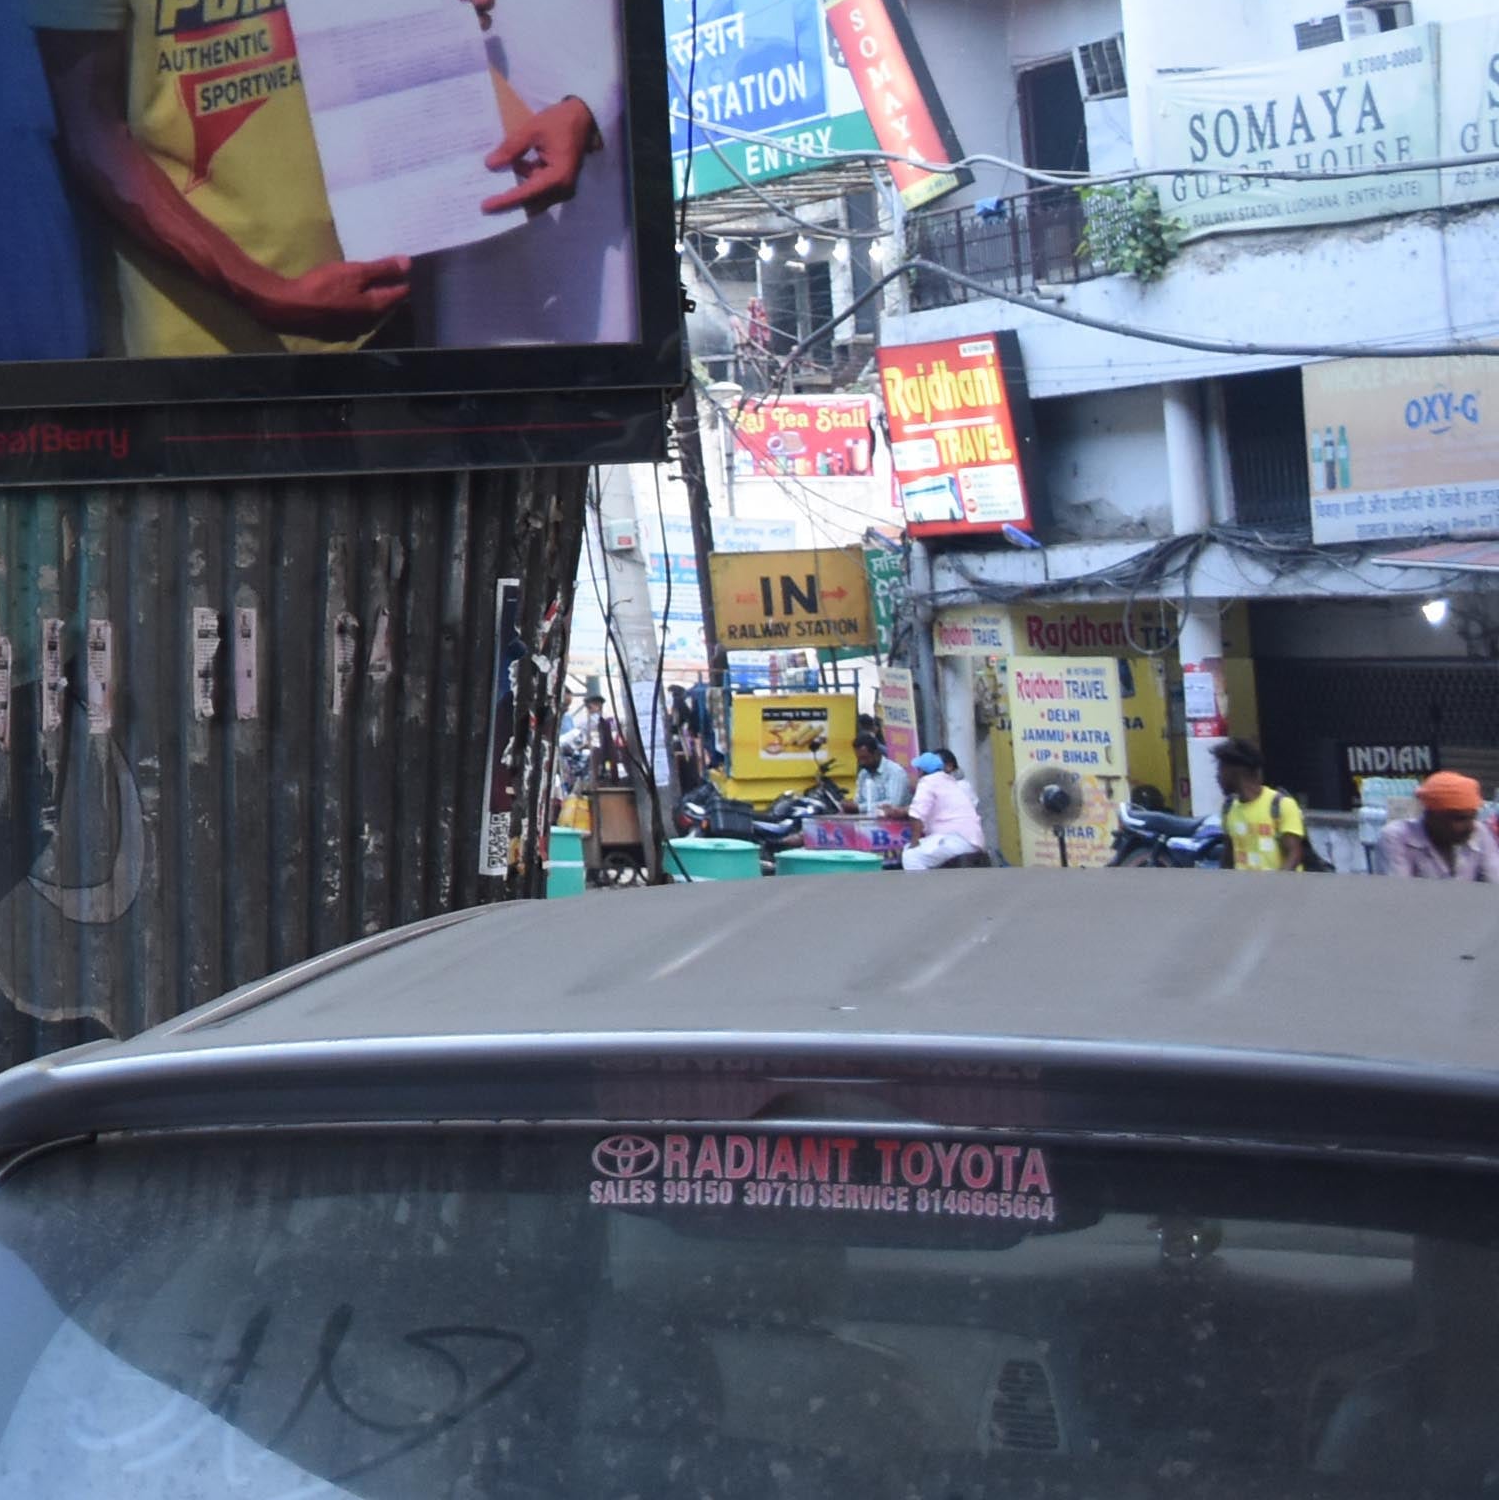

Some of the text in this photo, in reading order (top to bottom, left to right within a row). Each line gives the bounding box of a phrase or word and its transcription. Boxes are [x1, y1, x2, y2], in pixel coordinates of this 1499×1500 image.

[157, 28, 271, 74] AUTHENTIC
[199, 63, 303, 115] SPORTWEA
[692, 60, 807, 124] STATION
[1188, 80, 1385, 164] SOMAYA
[744, 126, 834, 177] ENTRY
[1171, 159, 1275, 202] GUEST
[1294, 135, 1412, 176] HOUSE
[882, 353, 1003, 424] Rajdhani
[1404, 389, 1480, 430] OXY-G
[771, 407, 810, 430] Tea
[816, 407, 868, 432] Stall
[934, 423, 1013, 466] TRAVEL
[760, 573, 821, 617] IN
[727, 618, 859, 640] RAILWAY STATION
[972, 627, 1003, 649] TRAVEL
[1026, 614, 1136, 653] Rajdhani
[1015, 671, 1109, 705] Rajdhani TRAVEL
[1021, 728, 1112, 745] JAMMU KATRA
[1046, 708, 1082, 723] DELHI
[1035, 749, 1101, 765] UP BIHAR
[1347, 745, 1433, 772] INDIAN
[662, 1133, 1052, 1195] RADIANT TOYOTA
[589, 1179, 1057, 1223] SALES 99150 30710 SERVICE 8146665664
